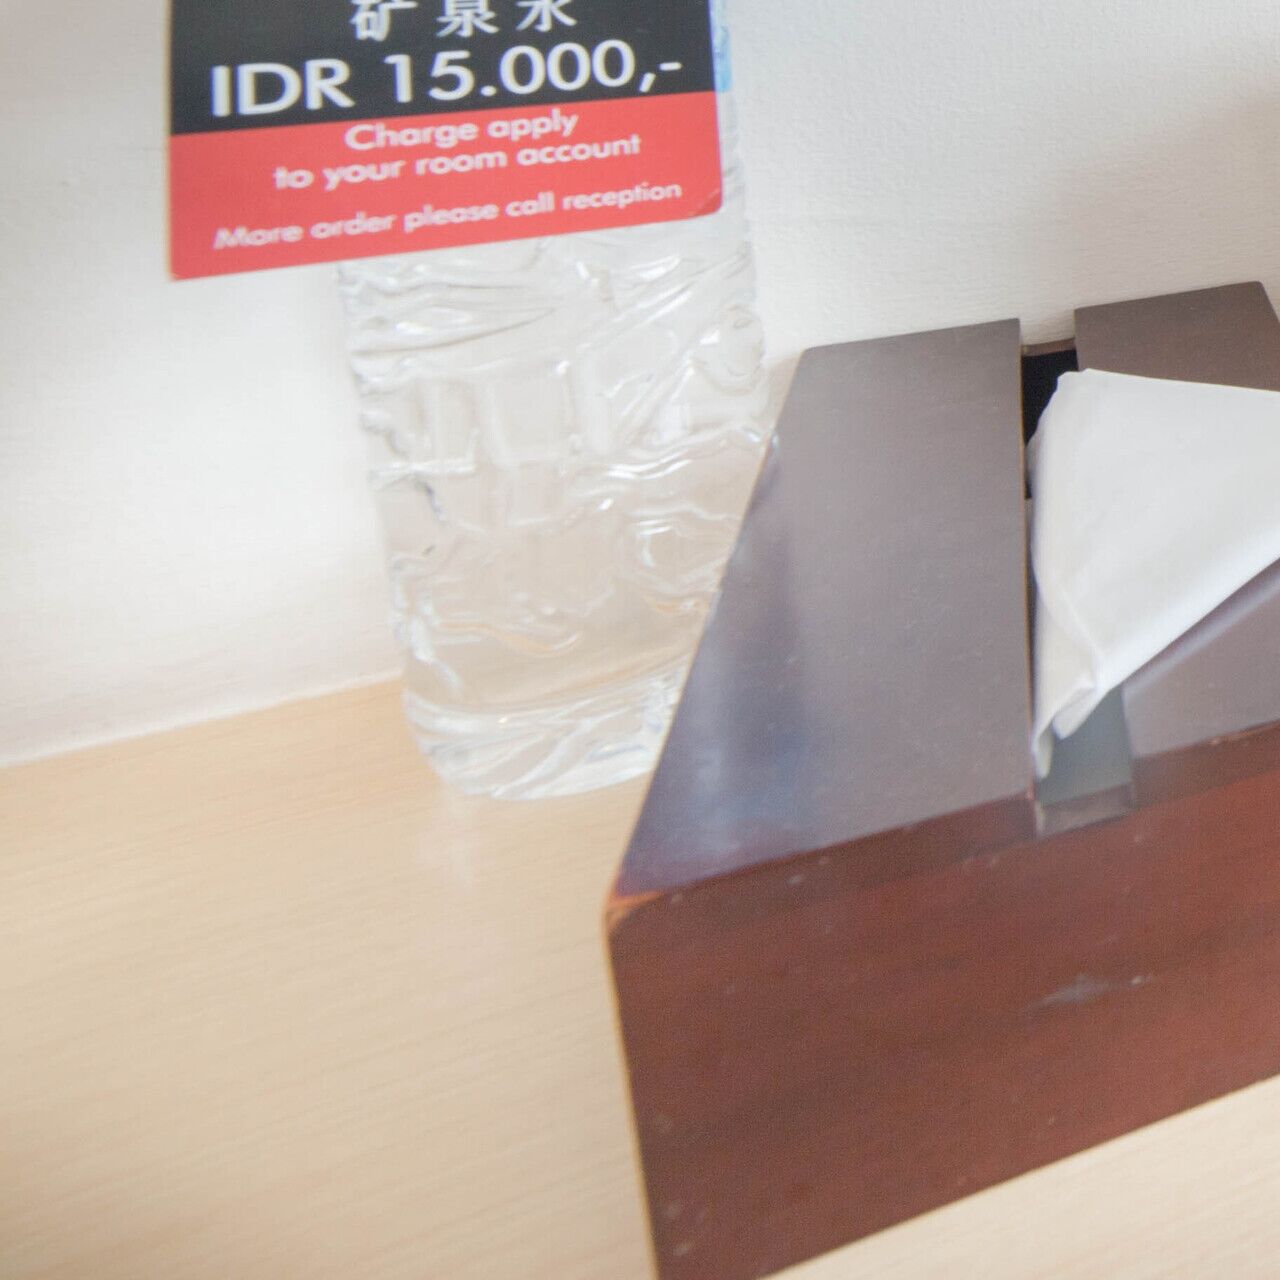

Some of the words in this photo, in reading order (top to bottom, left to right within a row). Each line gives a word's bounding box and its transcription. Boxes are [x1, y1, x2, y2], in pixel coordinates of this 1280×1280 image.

[211, 58, 356, 117] IDR
[384, 39, 683, 103] 15.000,-
[344, 118, 478, 151] Charge
[488, 109, 579, 141] apply
[273, 168, 314, 189] to
[324, 160, 404, 190] your
[415, 151, 507, 176] room
[517, 134, 642, 166] account
[213, 222, 304, 249] More
[310, 210, 396, 239] order
[404, 198, 498, 231] please
[506, 193, 555, 217] call
[564, 181, 683, 213] reception
